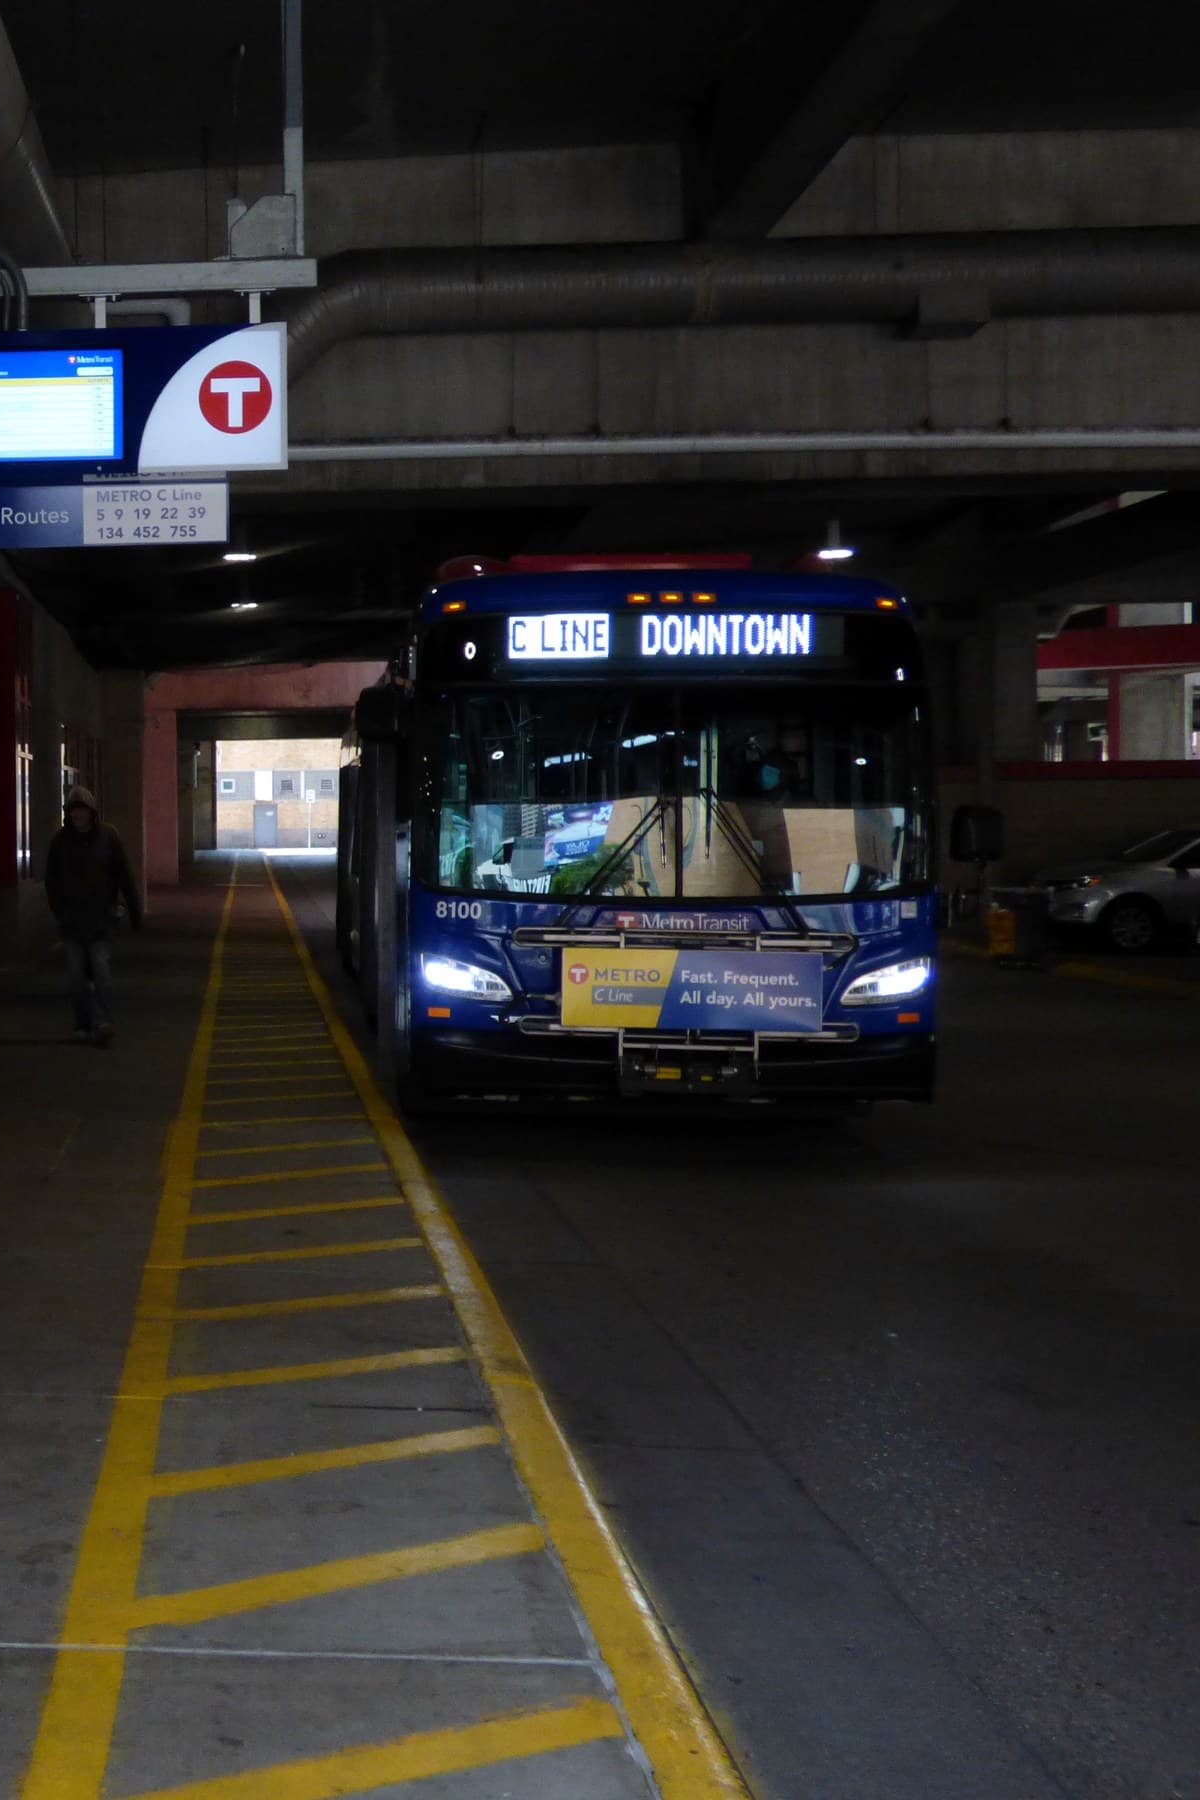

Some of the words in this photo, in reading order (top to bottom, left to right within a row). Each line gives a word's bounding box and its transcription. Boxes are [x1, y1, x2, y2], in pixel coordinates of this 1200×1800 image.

[97, 489, 152, 502] METRO
[157, 489, 167, 502] C
[173, 488, 202, 501] Line
[0, 506, 70, 526] Routes
[96, 509, 105, 521] 5
[115, 508, 124, 520] 9
[134, 508, 150, 520] 19
[160, 507, 178, 519] 22
[188, 506, 206, 518] 39
[99, 527, 123, 539] 134
[133, 526, 160, 538] 452
[170, 525, 197, 537] 755
[512, 620, 527, 651] C
[541, 620, 606, 652] LINE
[640, 613, 813, 656] DOWNTOWN
[435, 901, 482, 920] 8100
[594, 969, 661, 983] METRO
[681, 970, 718, 984] Fast.
[724, 970, 799, 987] Frequent.
[594, 988, 604, 1001] C
[608, 988, 634, 1002] Line
[680, 991, 701, 1005] All
[706, 992, 737, 1009] day.
[743, 992, 764, 1006] All
[769, 994, 818, 1009] yours.
